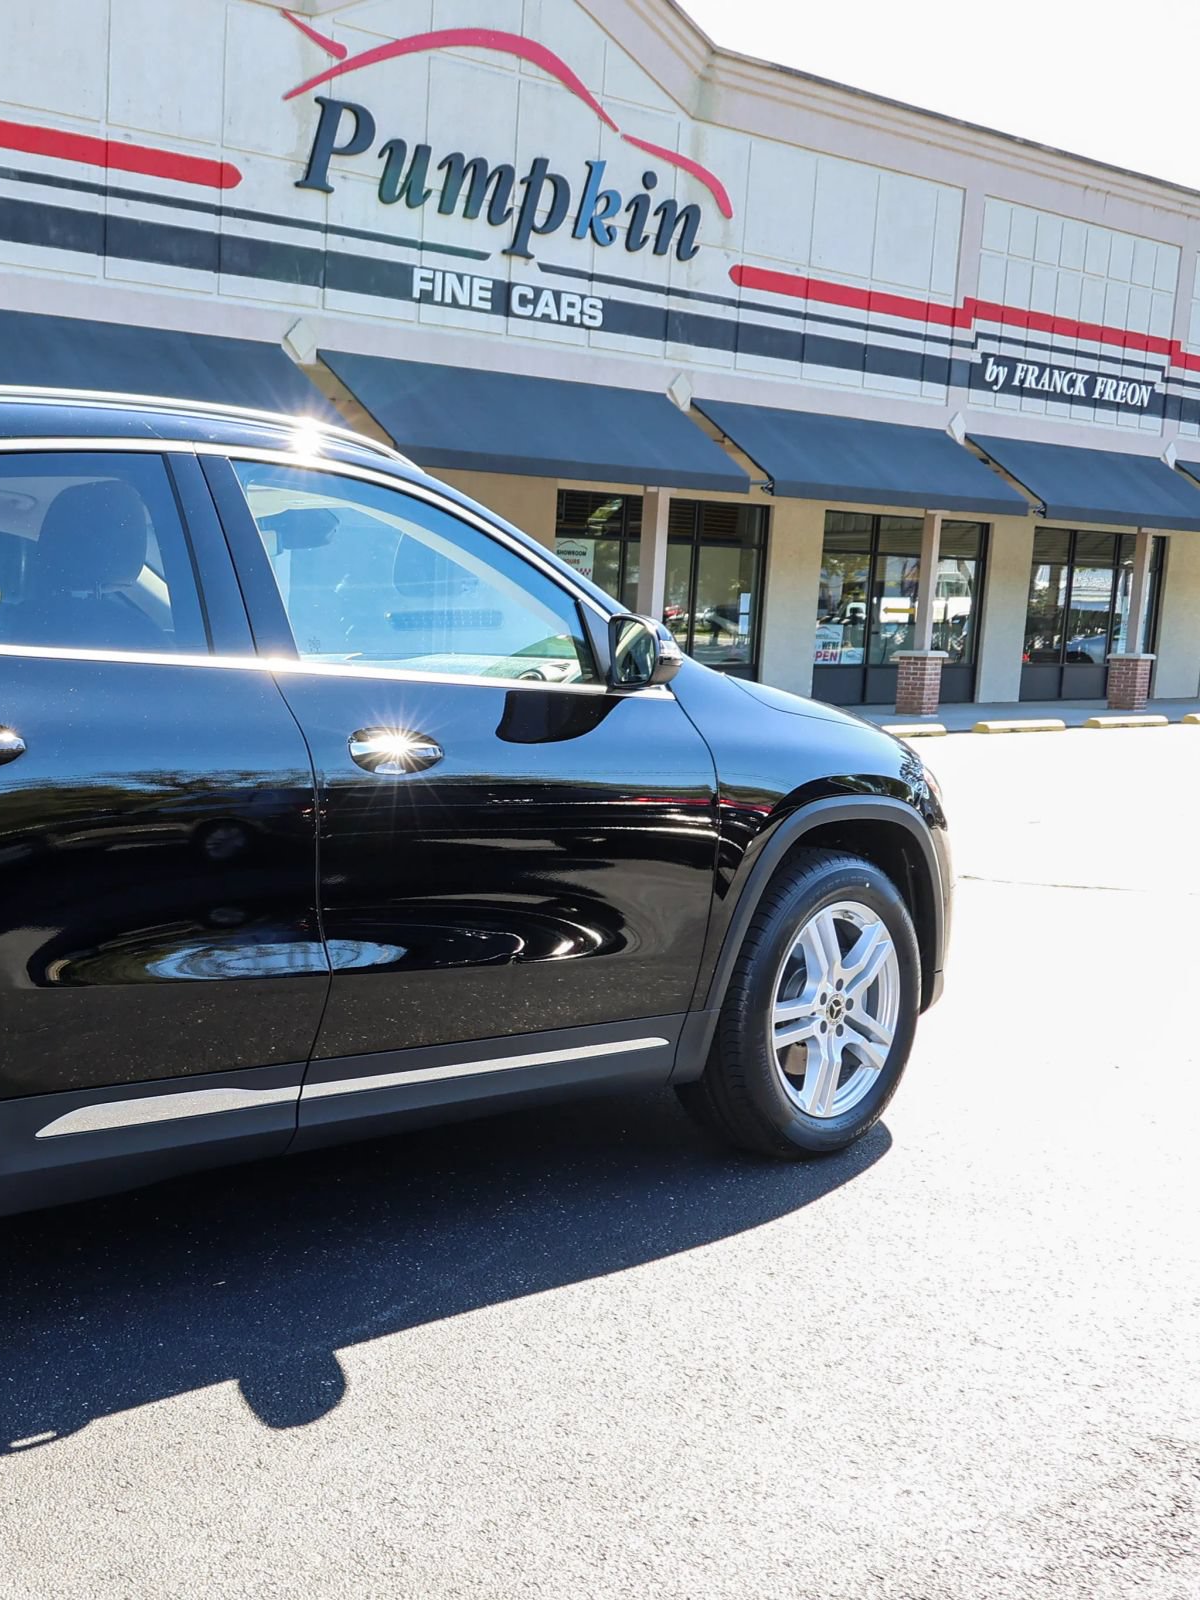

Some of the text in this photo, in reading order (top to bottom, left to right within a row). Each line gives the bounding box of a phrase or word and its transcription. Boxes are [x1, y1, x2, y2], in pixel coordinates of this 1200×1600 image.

[294, 96, 701, 262] Pumpkin
[412, 268, 604, 328] FINE CARS
[984, 357, 1152, 408] by FRANCK FREON
[815, 650, 838, 661] PEN
